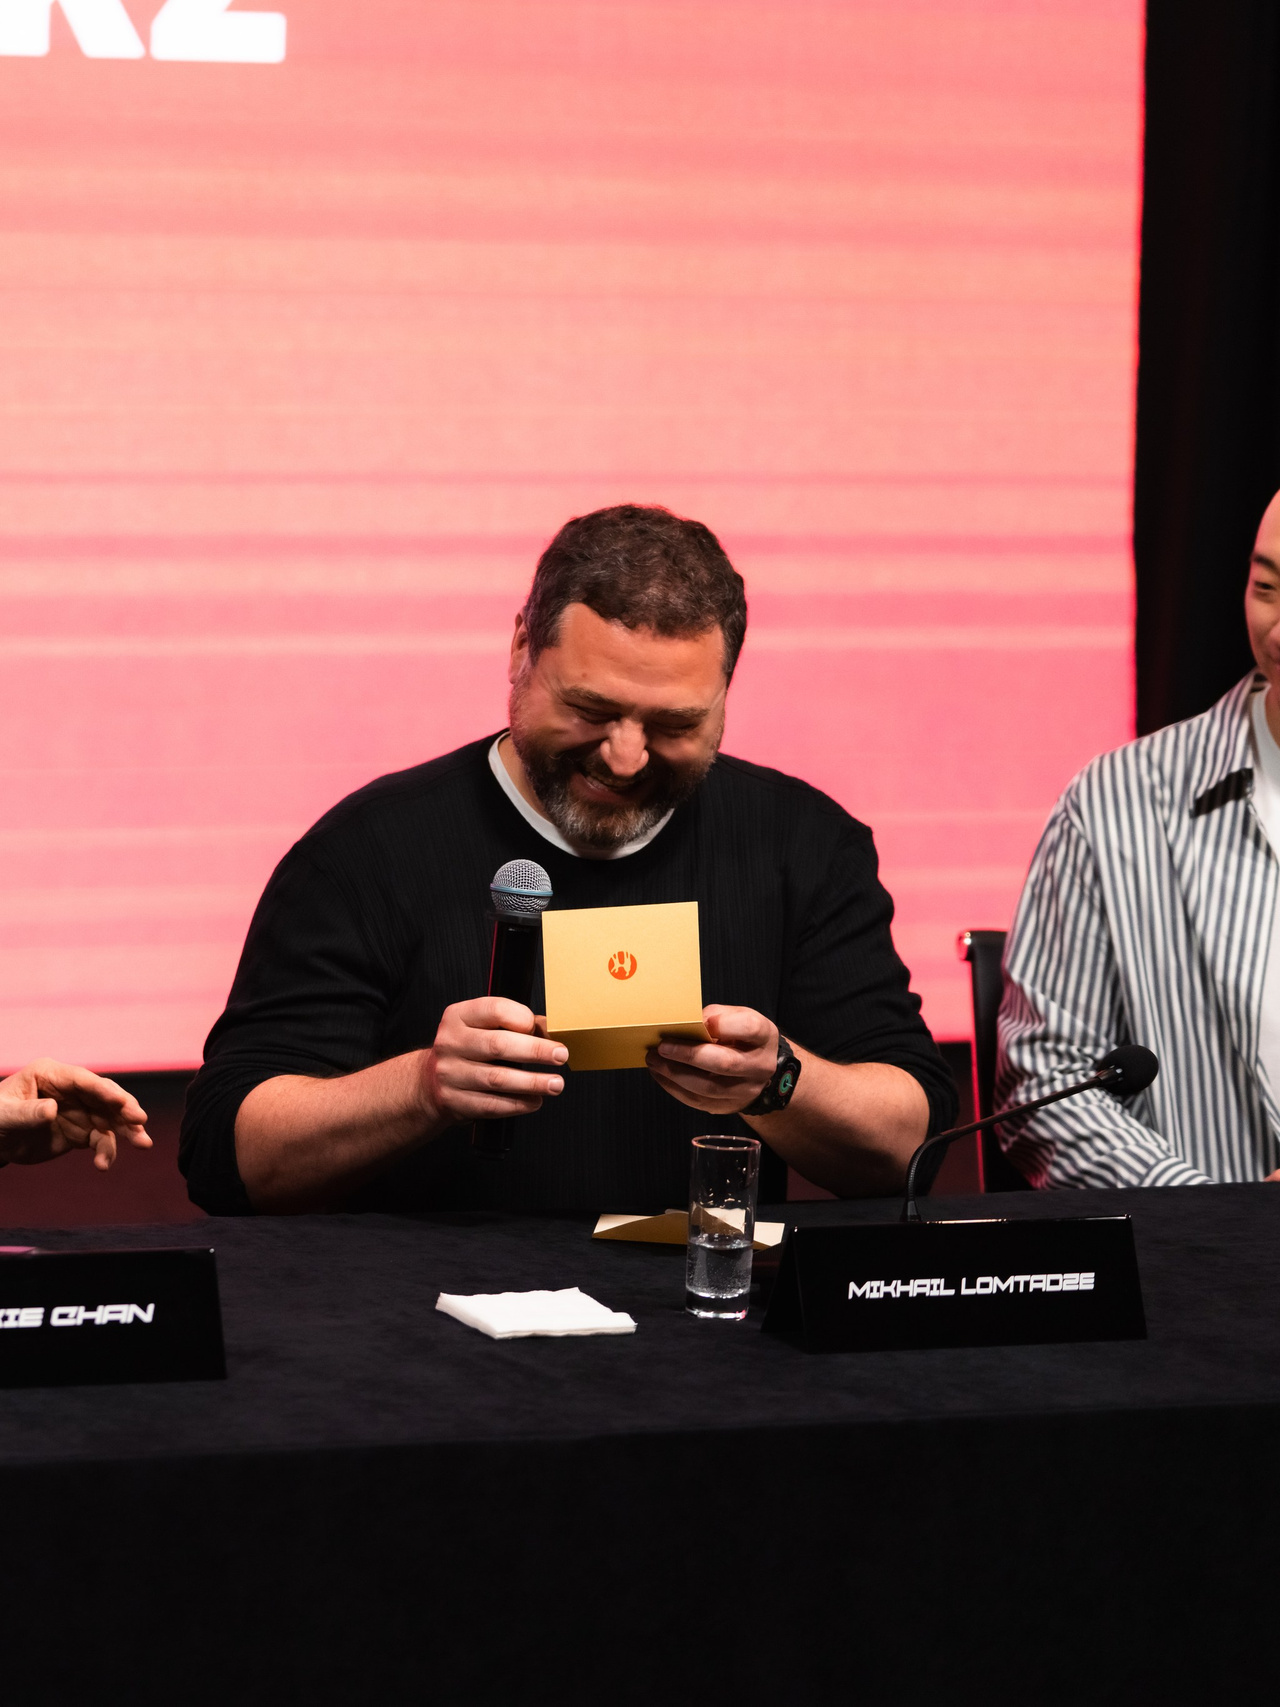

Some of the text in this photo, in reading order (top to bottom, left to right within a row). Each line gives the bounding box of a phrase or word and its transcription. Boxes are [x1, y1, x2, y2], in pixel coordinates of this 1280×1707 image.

[847, 1271, 1096, 1300] MIKHAIL LOMTADZE
[49, 1302, 156, 1327] CHAN
